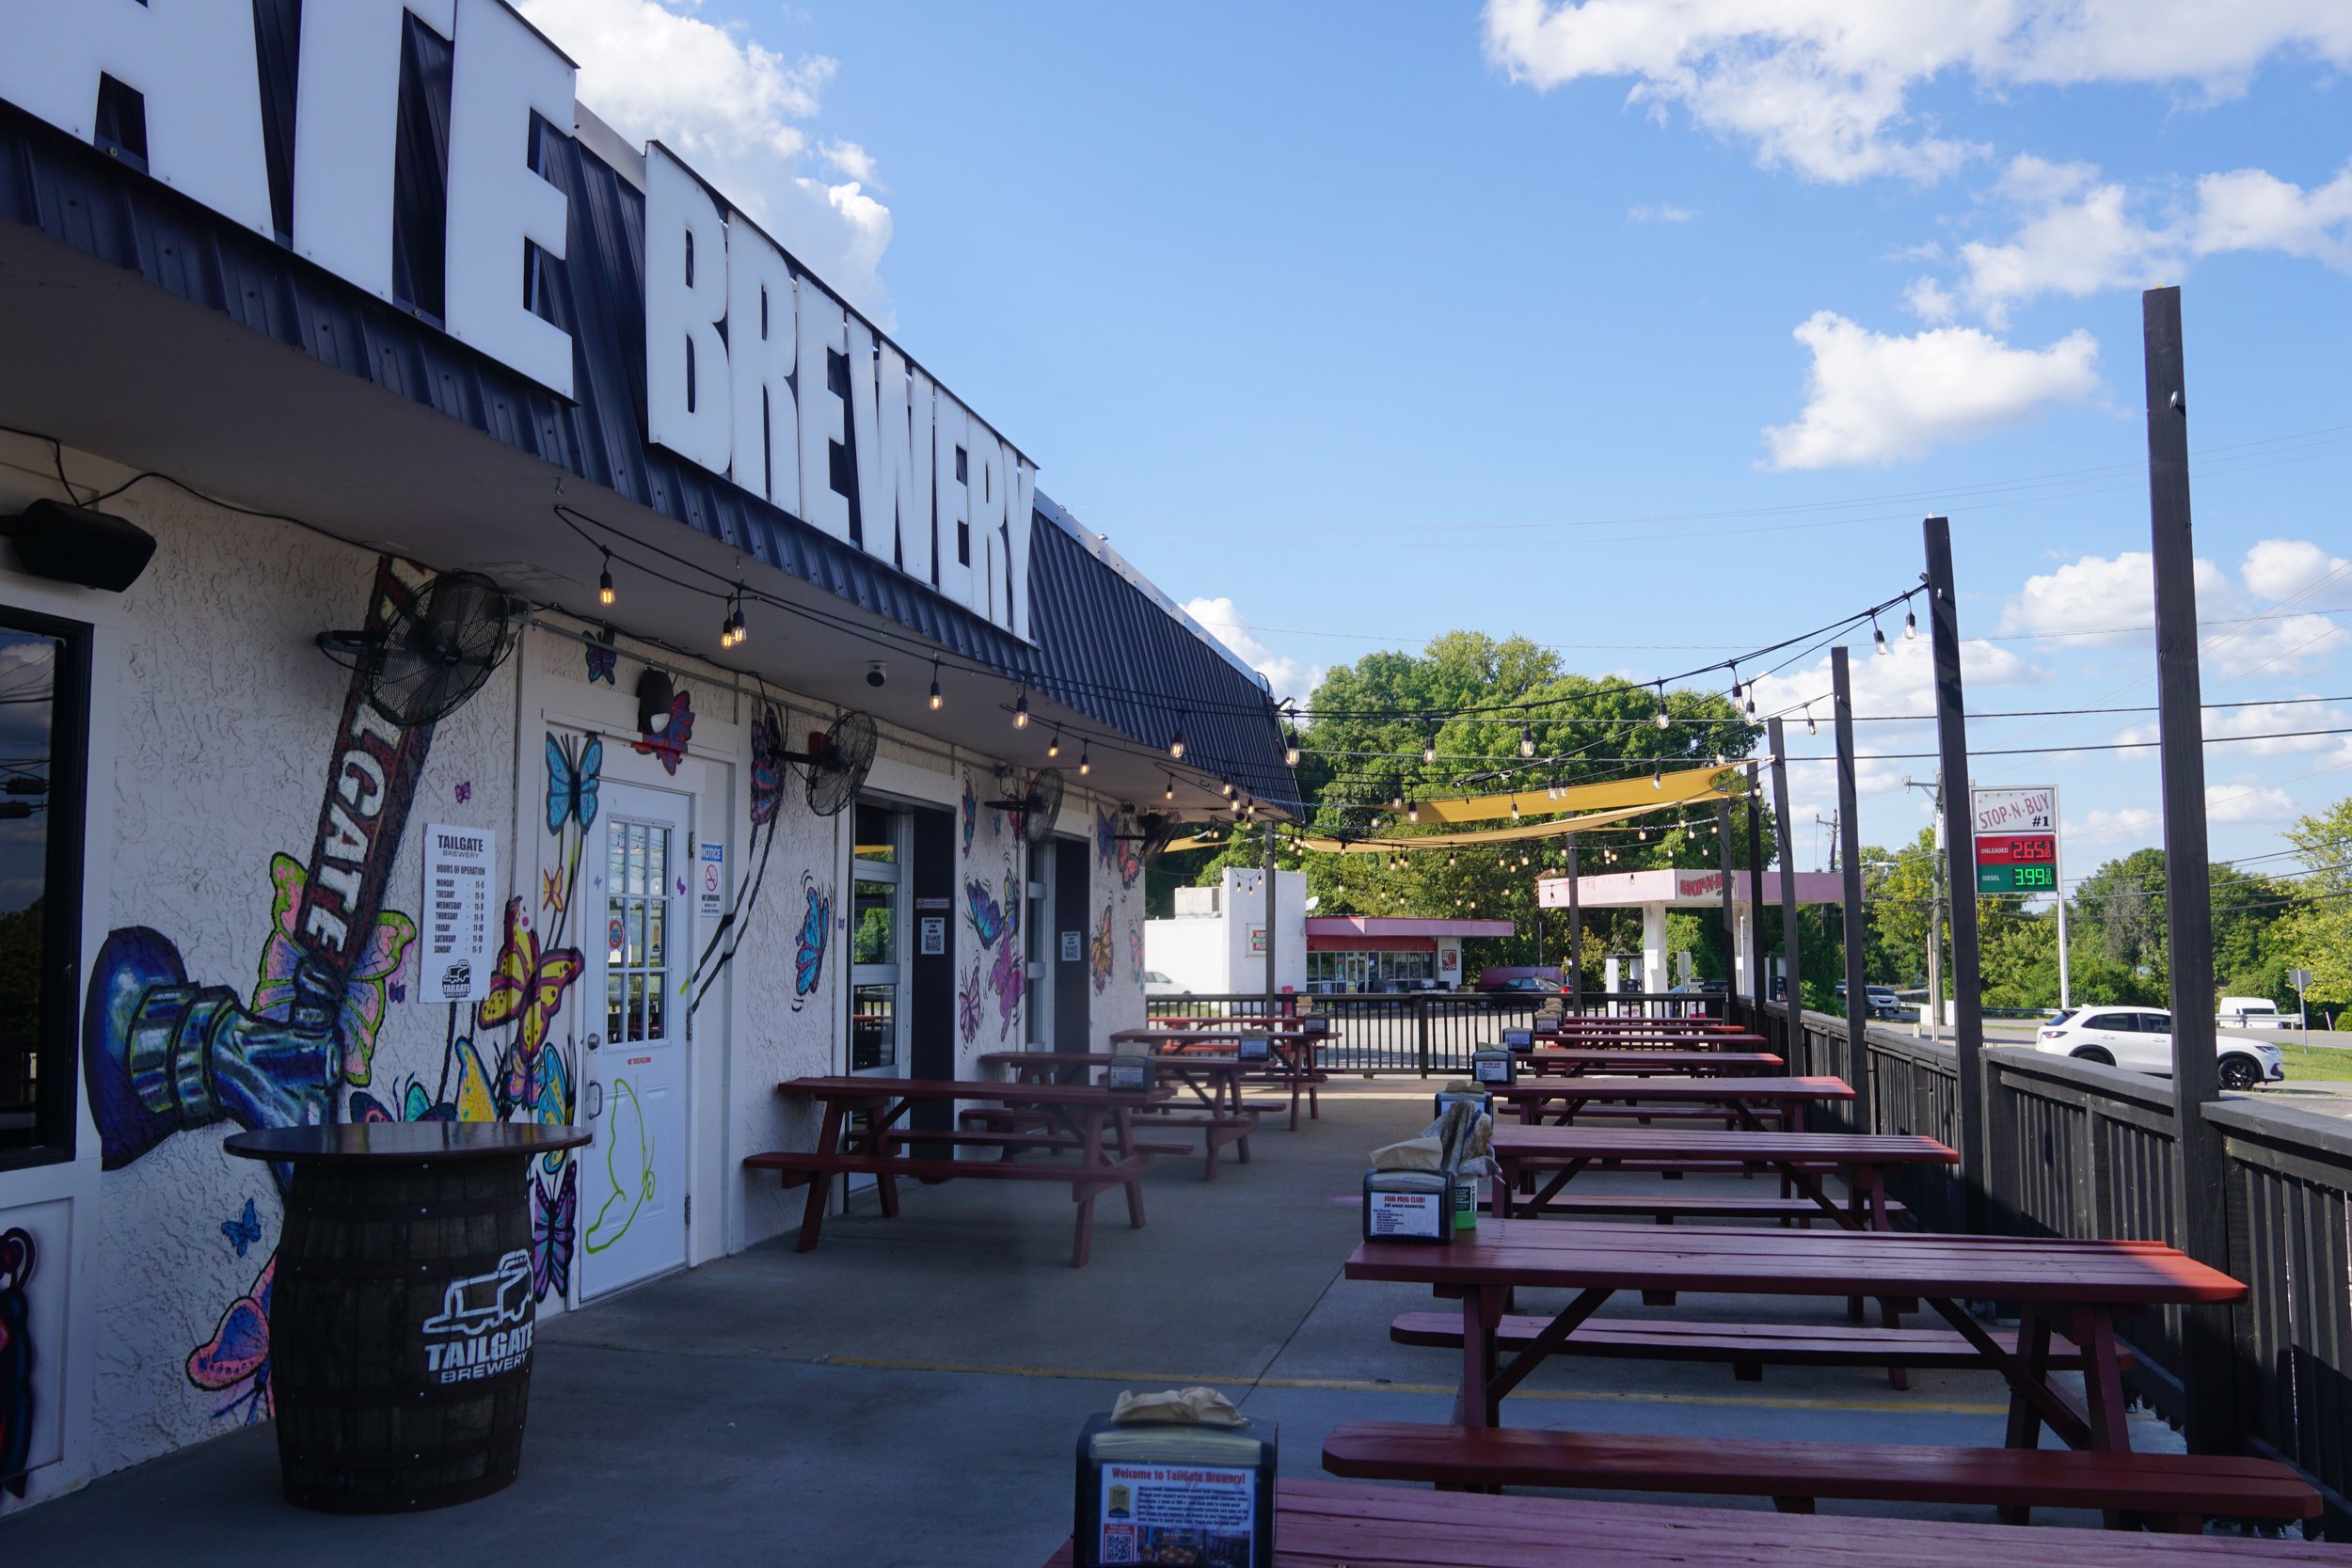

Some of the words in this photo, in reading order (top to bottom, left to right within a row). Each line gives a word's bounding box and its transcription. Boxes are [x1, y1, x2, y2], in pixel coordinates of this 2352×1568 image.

[644, 140, 1037, 642] BREWERY
[2032, 816, 2049, 828] #1
[437, 834, 484, 852] TAILGATE
[442, 849, 480, 859] BREWERY
[702, 847, 722, 860] NOTICE
[2012, 841, 2044, 859] 2.65
[437, 863, 453, 874] HOURS
[454, 865, 460, 875] OF
[460, 866, 485, 877] OPERATION
[2014, 867, 2045, 886] 3.99
[436, 879, 454, 888] MONDAY
[436, 890, 455, 898] TUESDAY
[436, 901, 462, 911] WEDNESDAY
[436, 911, 458, 921] THURSDAY
[435, 924, 451, 932] FRIDAY
[435, 934, 456, 943] SATURDAY
[434, 945, 452, 954] SUNDAY
[442, 983, 470, 994] TAILGATE
[424, 1320, 533, 1371] TAILGATE
[440, 1351, 528, 1384] BREWERY
[1111, 1467, 1152, 1481] Welcome
[1154, 1469, 1164, 1481] to
[1205, 1471, 1246, 1484] Brewery!
